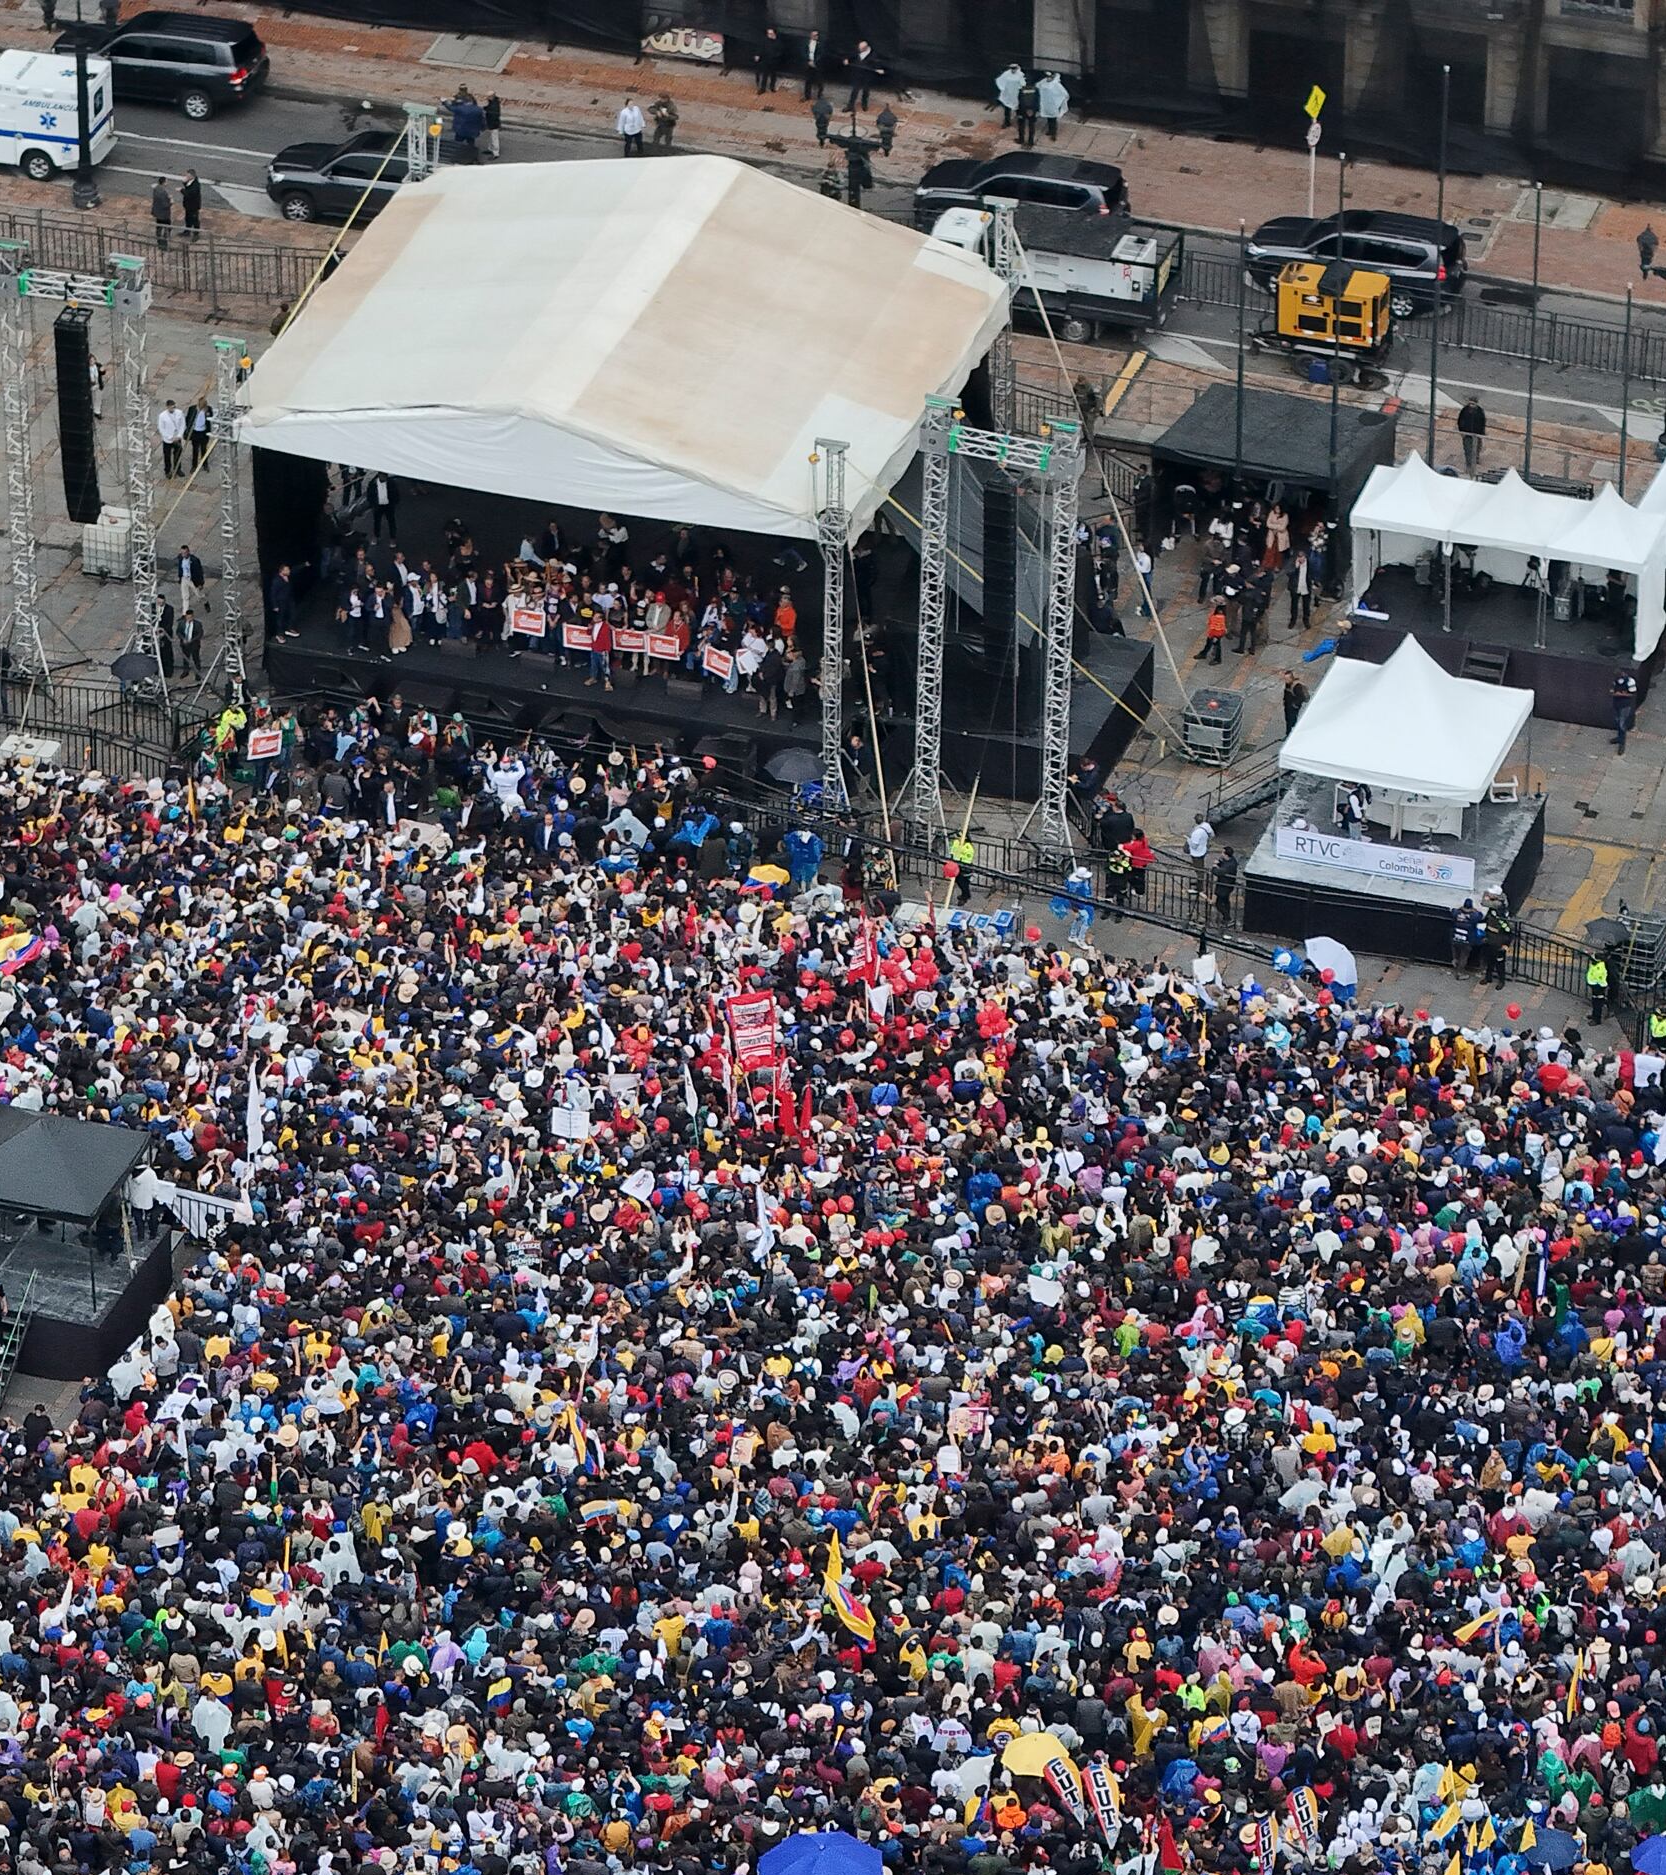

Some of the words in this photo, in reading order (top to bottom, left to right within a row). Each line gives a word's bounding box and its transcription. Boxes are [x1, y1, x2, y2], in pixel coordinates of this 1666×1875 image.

[1295, 837, 1341, 859] RTVC
[1397, 852, 1425, 866] Señal
[1379, 860, 1424, 876] Colombia
[331, 1755, 340, 1768] 3
[1053, 1759, 1081, 1805] CUT
[1093, 1770, 1116, 1828] CUT
[1296, 1790, 1315, 1838] CUT
[1260, 1822, 1274, 1869] CUT
